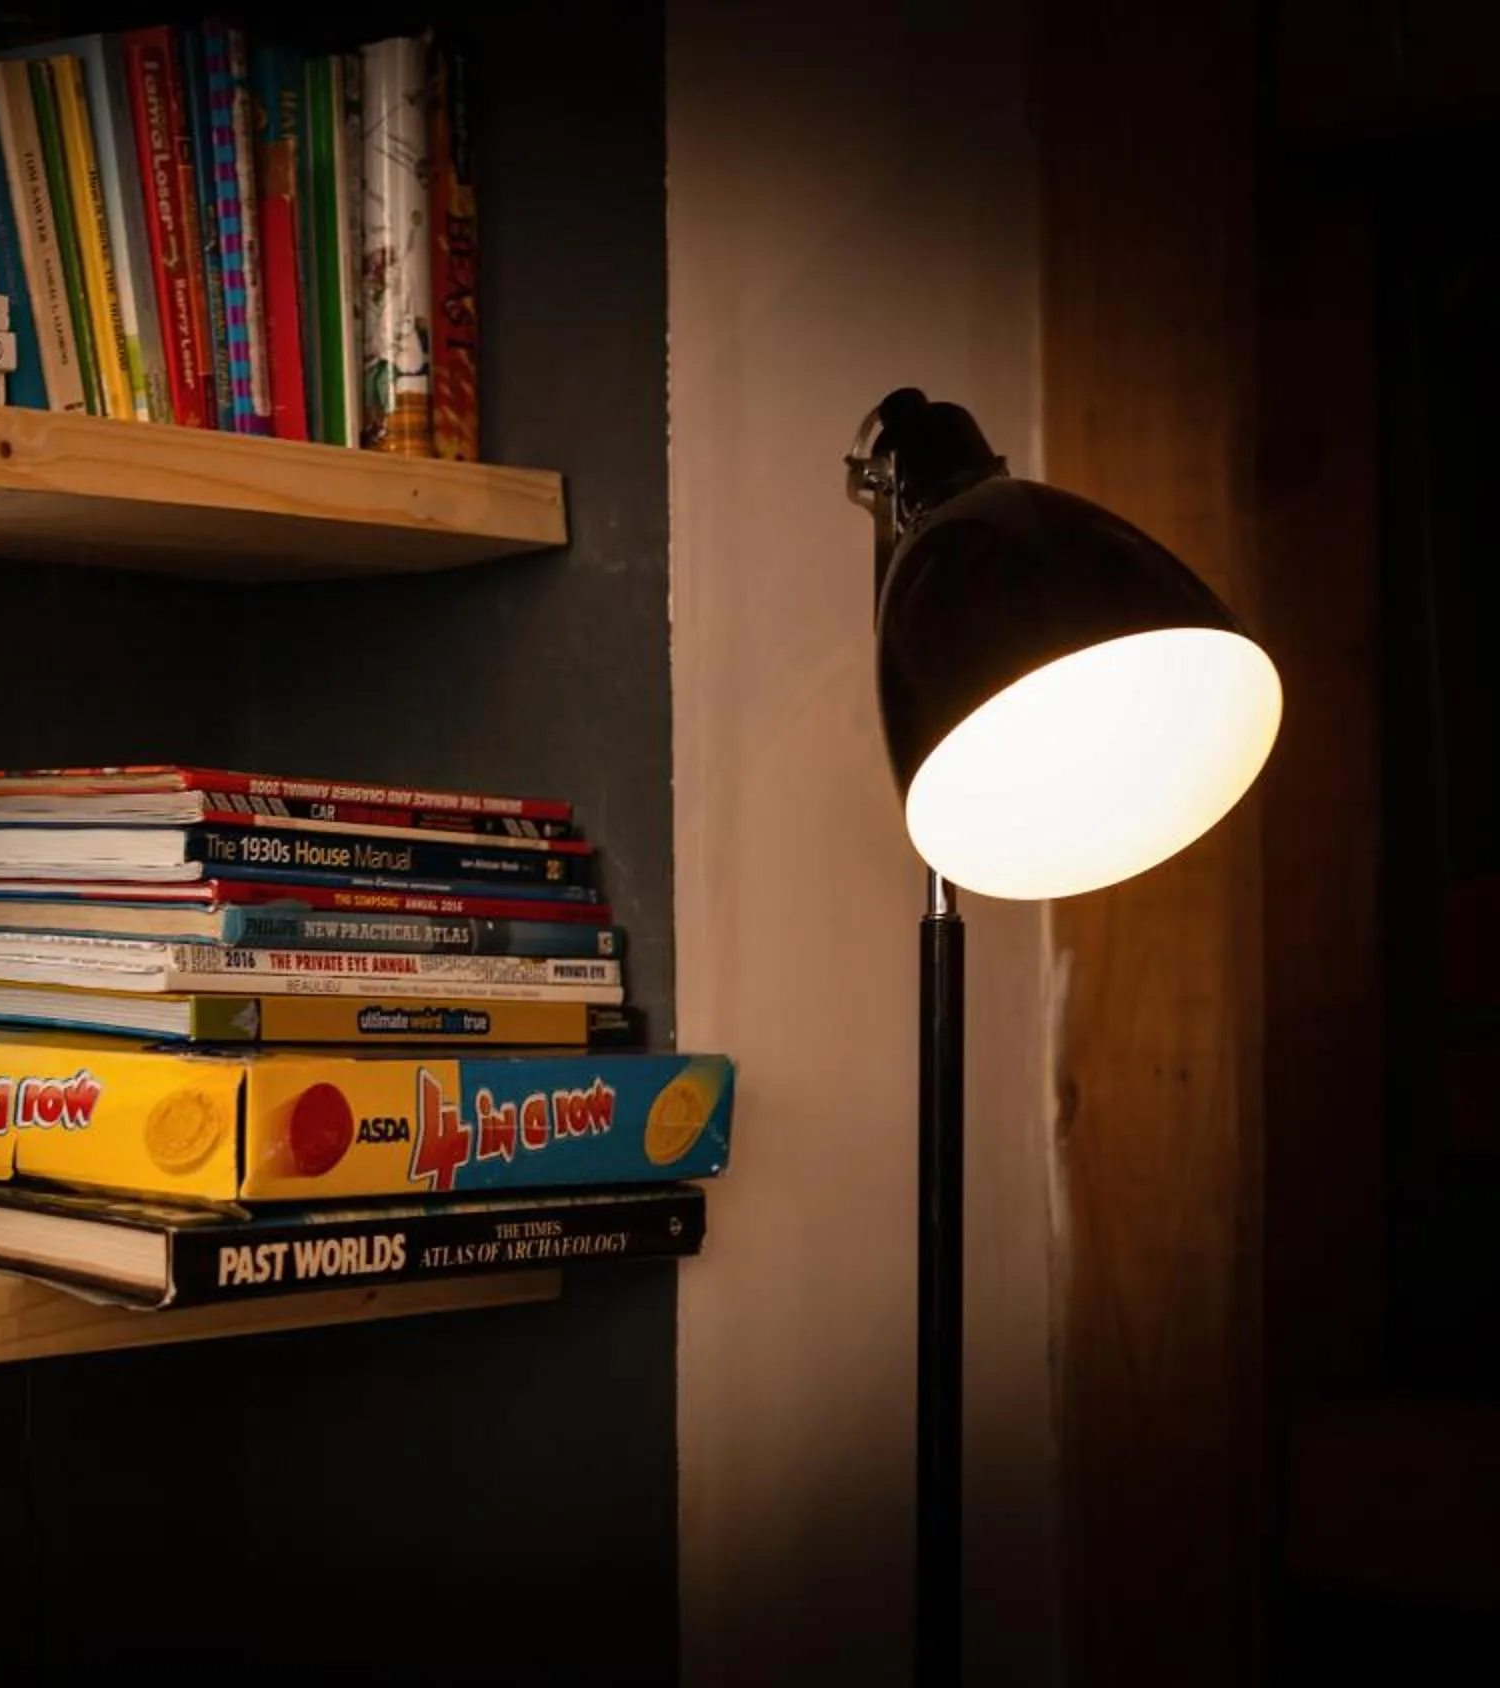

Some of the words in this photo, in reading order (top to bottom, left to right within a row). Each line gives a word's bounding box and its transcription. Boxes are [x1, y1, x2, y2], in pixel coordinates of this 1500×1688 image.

[152, 152, 174, 231] Loser
[30, 185, 48, 244] SAWYER
[443, 212, 475, 349] BEAST
[174, 278, 191, 337] Barry
[180, 338, 196, 391] Loser
[310, 803, 336, 820] CAR
[205, 833, 239, 859] The
[239, 836, 291, 863] 1930s
[294, 841, 350, 867] House
[353, 844, 413, 871] Manual
[304, 920, 340, 939] NEW
[341, 922, 421, 942] PRACTICAL
[423, 925, 470, 944] ATLAS
[224, 950, 256, 968] 2016
[269, 952, 293, 970] THE
[296, 954, 345, 971] PRIVATE
[347, 956, 369, 973] EYE
[371, 957, 419, 975] ANNUAL
[553, 964, 583, 979] PRIVATE
[585, 966, 607, 980] EYE
[286, 978, 341, 994] BEAULIEU
[359, 1010, 409, 1029] ultimate
[464, 1013, 488, 1031] true
[15, 1069, 102, 1130] row
[356, 1117, 410, 1144] ASDA
[408, 1066, 471, 1191] 4
[520, 1093, 548, 1150] a
[551, 1077, 616, 1139] row
[496, 1223, 522, 1240] THE
[522, 1220, 563, 1239] TIMES
[218, 1241, 290, 1287] PAST
[293, 1233, 407, 1278] WORLDS
[419, 1245, 476, 1268] ATLAS
[477, 1242, 500, 1264] OF
[504, 1231, 632, 1263] ARCHAEOLOGY
